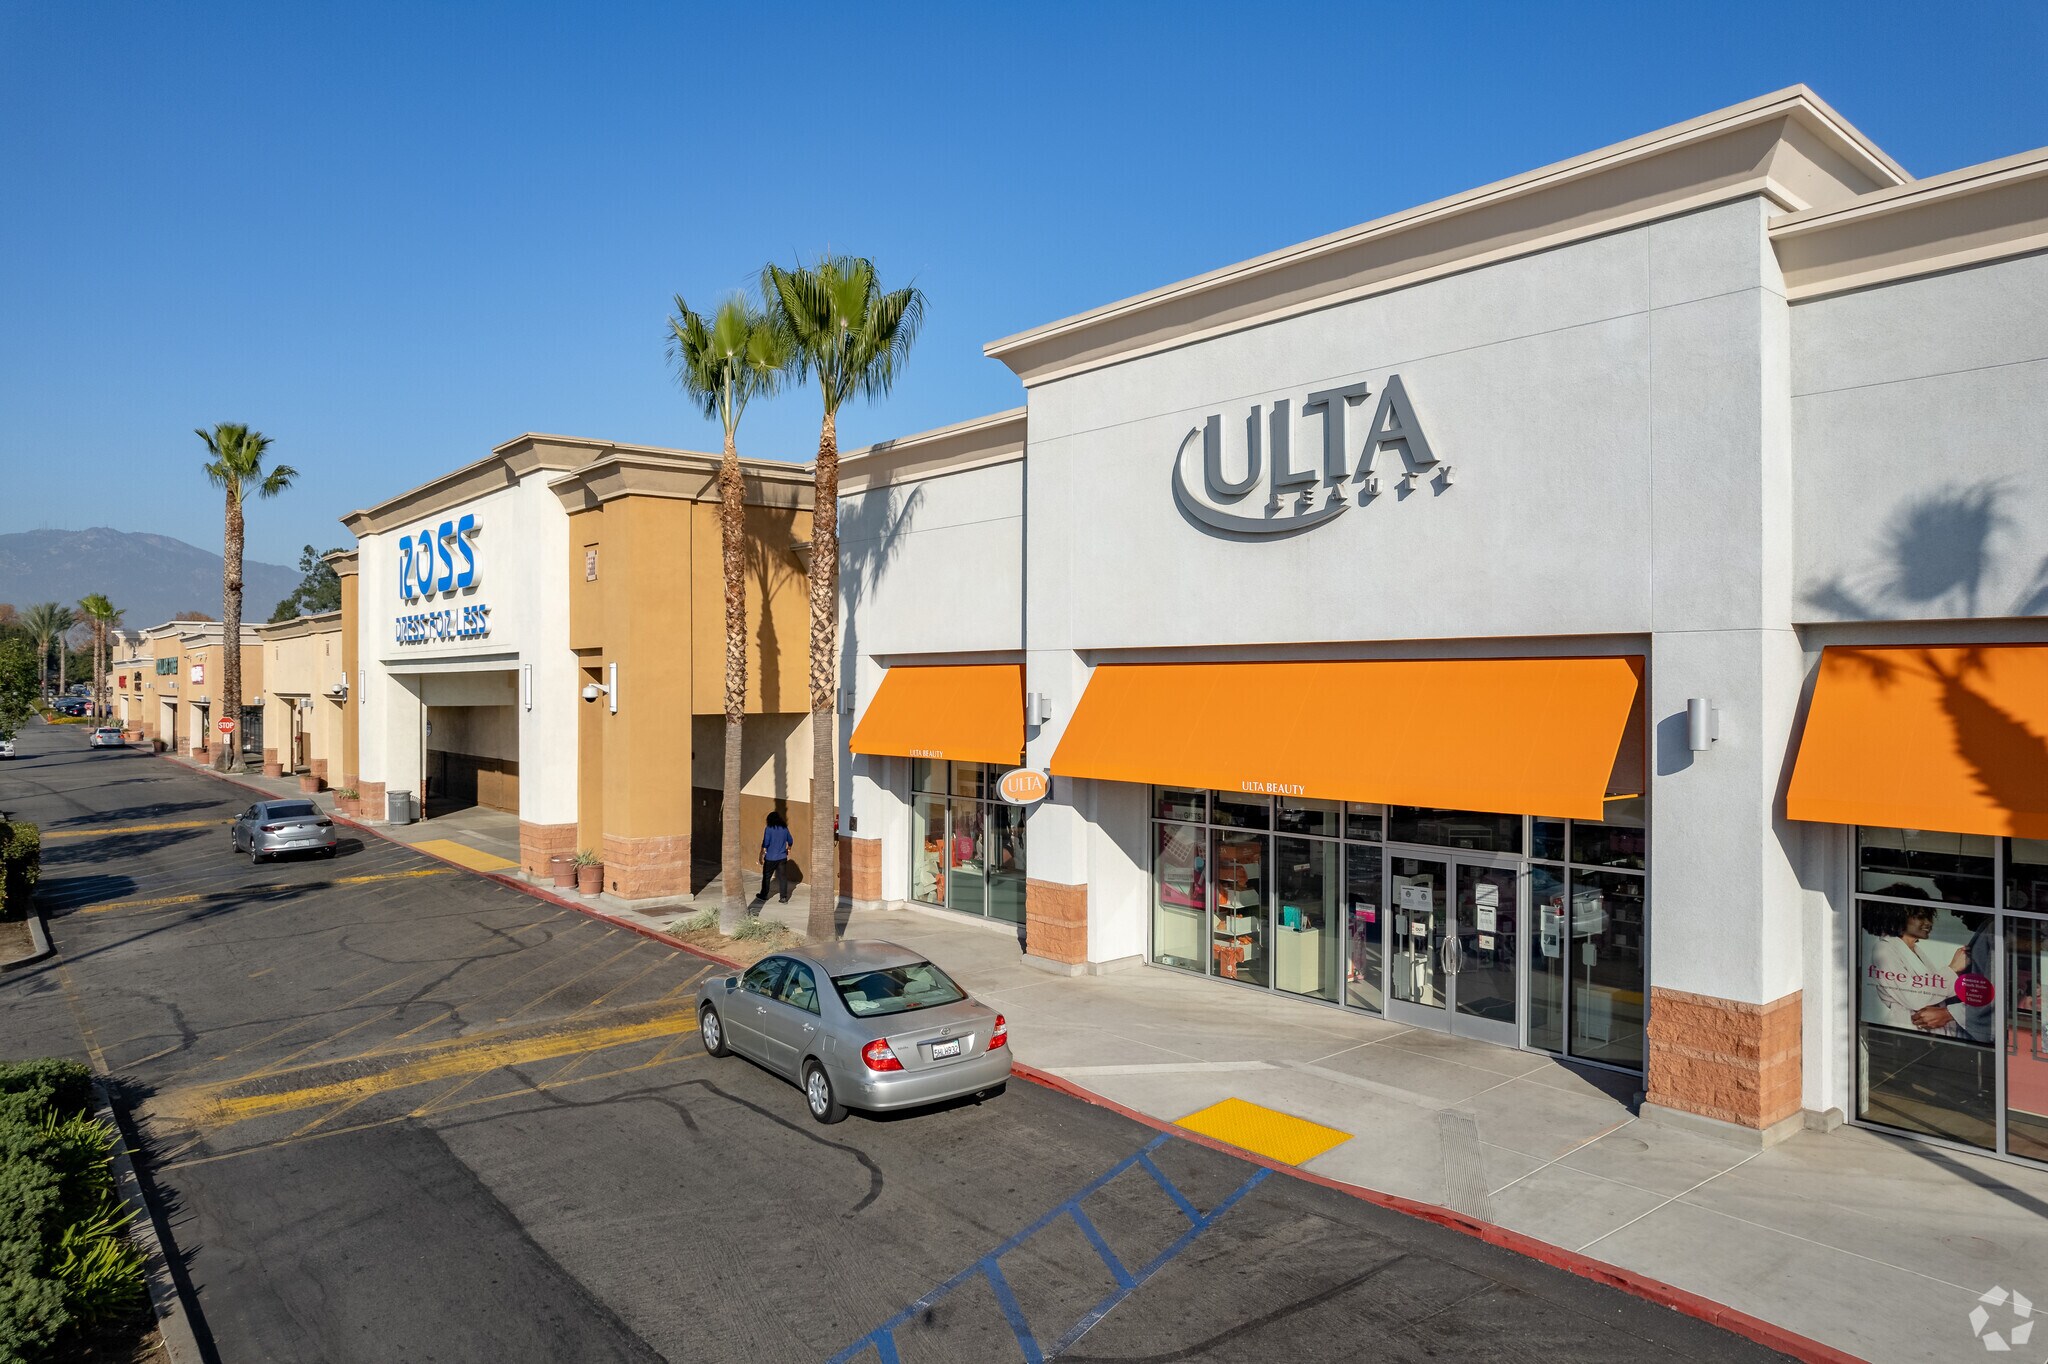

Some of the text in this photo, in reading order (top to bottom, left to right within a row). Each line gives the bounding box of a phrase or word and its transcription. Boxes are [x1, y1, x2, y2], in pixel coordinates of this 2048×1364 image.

[1204, 373, 1437, 495] ULTA
[1268, 464, 1458, 510] BEAUTY
[399, 513, 484, 600] ROSS
[396, 603, 492, 642] DRESS FOR LESS
[218, 721, 235, 729] STOP
[909, 749, 944, 758] ULTA BEAUTY
[1007, 776, 1043, 793] ULTA
[1241, 781, 1305, 795] ULTA BEAUTY
[1868, 964, 1948, 989] free gift
